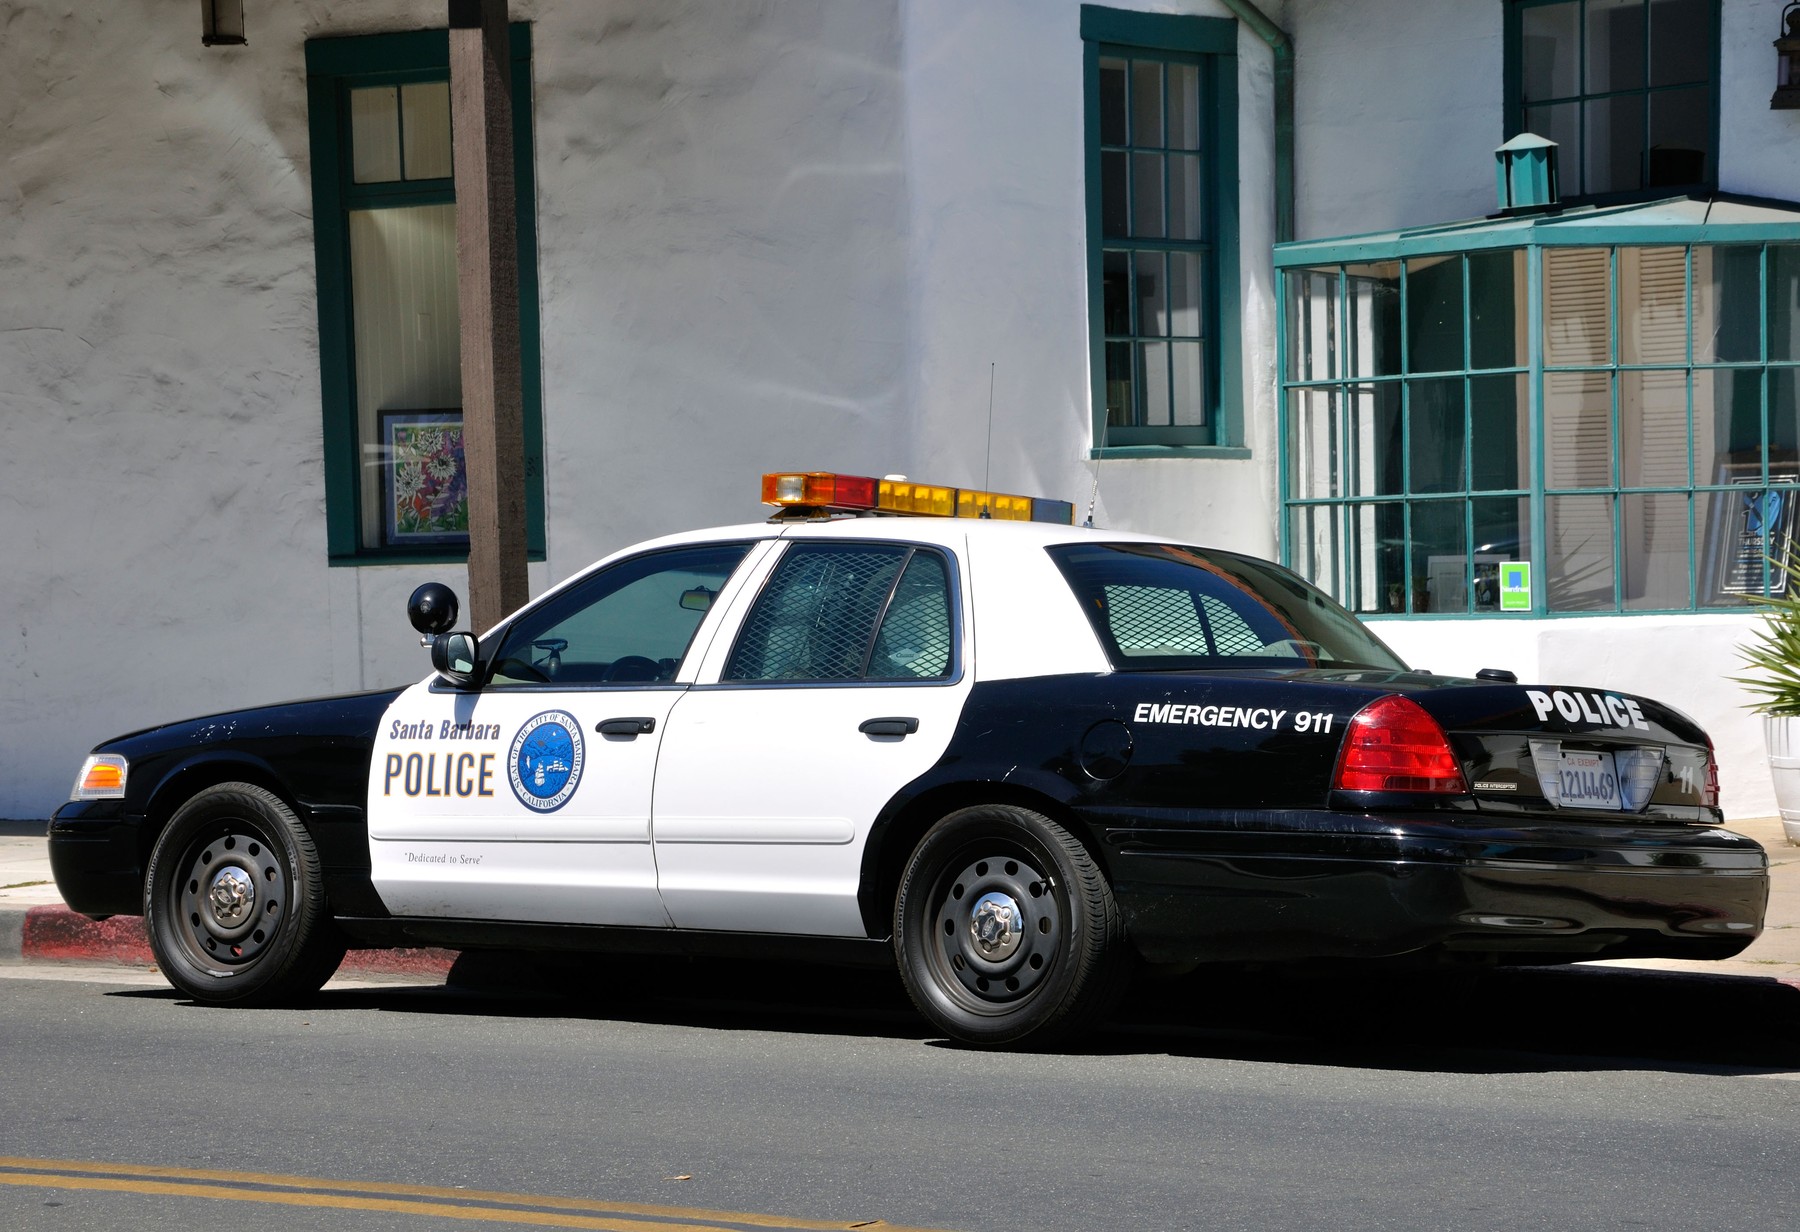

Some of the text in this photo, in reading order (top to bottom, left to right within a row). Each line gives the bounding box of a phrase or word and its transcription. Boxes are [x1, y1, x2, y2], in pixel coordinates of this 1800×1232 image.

[1738, 537, 1775, 545] THURSY
[530, 715, 549, 728] CITY
[1134, 703, 1334, 734] EMERGENCY 911
[1526, 690, 1650, 731] POLICE
[390, 719, 501, 740] Santa Barbara
[517, 727, 531, 745] THE
[560, 716, 578, 739] SANTA
[512, 749, 519, 760] OF
[568, 739, 582, 786] BARBARA
[1567, 757, 1600, 767] CA EXEMPT
[384, 752, 496, 799] POLICE
[511, 762, 522, 789] SEAL
[1559, 770, 1614, 800] 1214469
[1680, 765, 1694, 794] 11
[522, 791, 567, 808] CALIFORNIA
[449, 855, 457, 864] to
